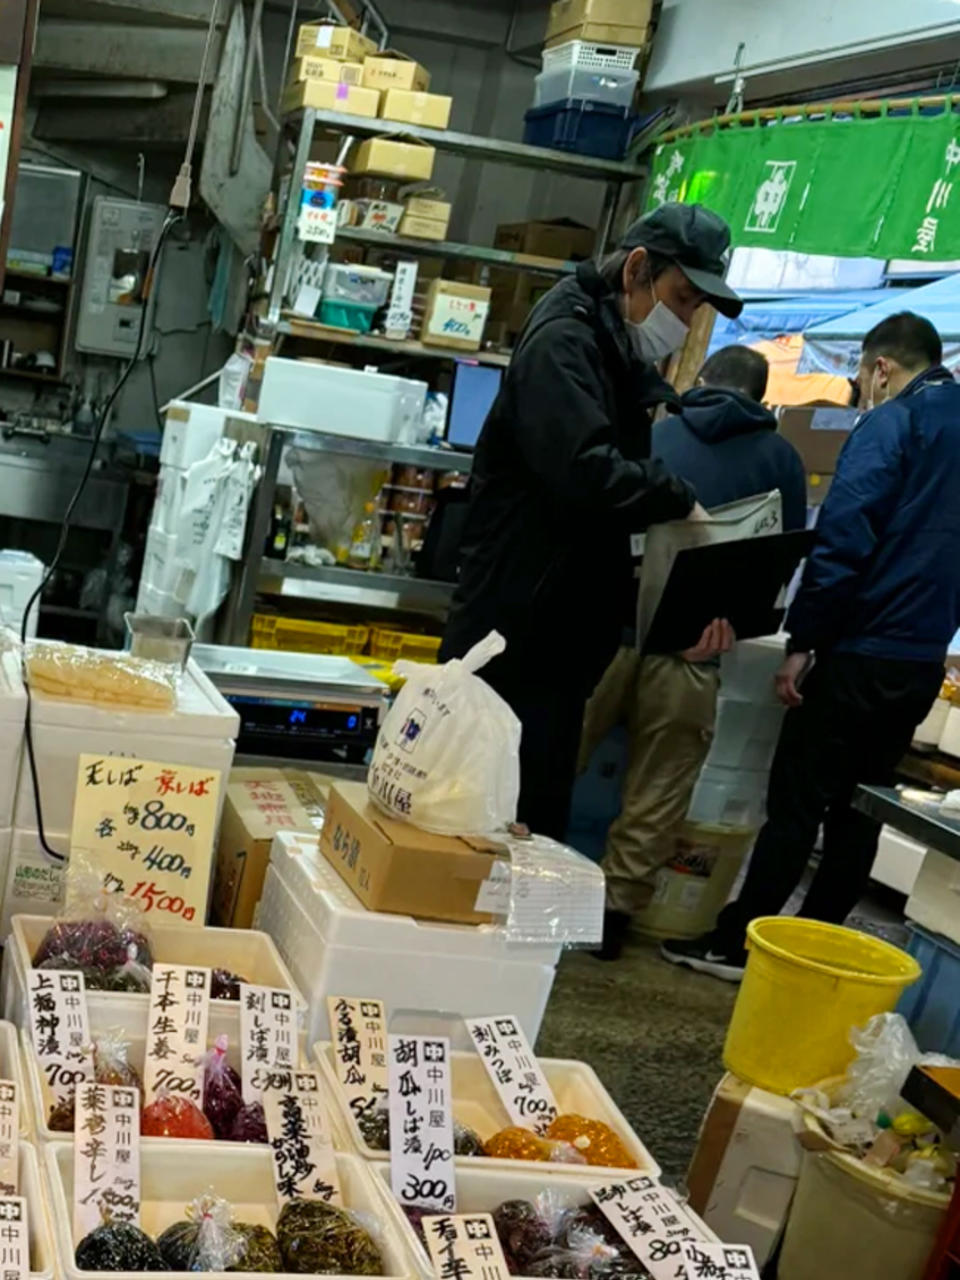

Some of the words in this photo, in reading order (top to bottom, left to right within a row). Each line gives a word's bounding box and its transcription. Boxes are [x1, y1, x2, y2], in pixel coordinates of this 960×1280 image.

[141, 799, 196, 837] 800円
[142, 845, 193, 880] 400円
[31, 973, 62, 1056] 上福神漬
[148, 970, 181, 1061] 千本生姜
[151, 1068, 201, 1101] 700円
[393, 1039, 424, 1155] 胡瓜しば漬
[423, 1142, 452, 1170] 1pc
[401, 1172, 455, 1211] 300円
